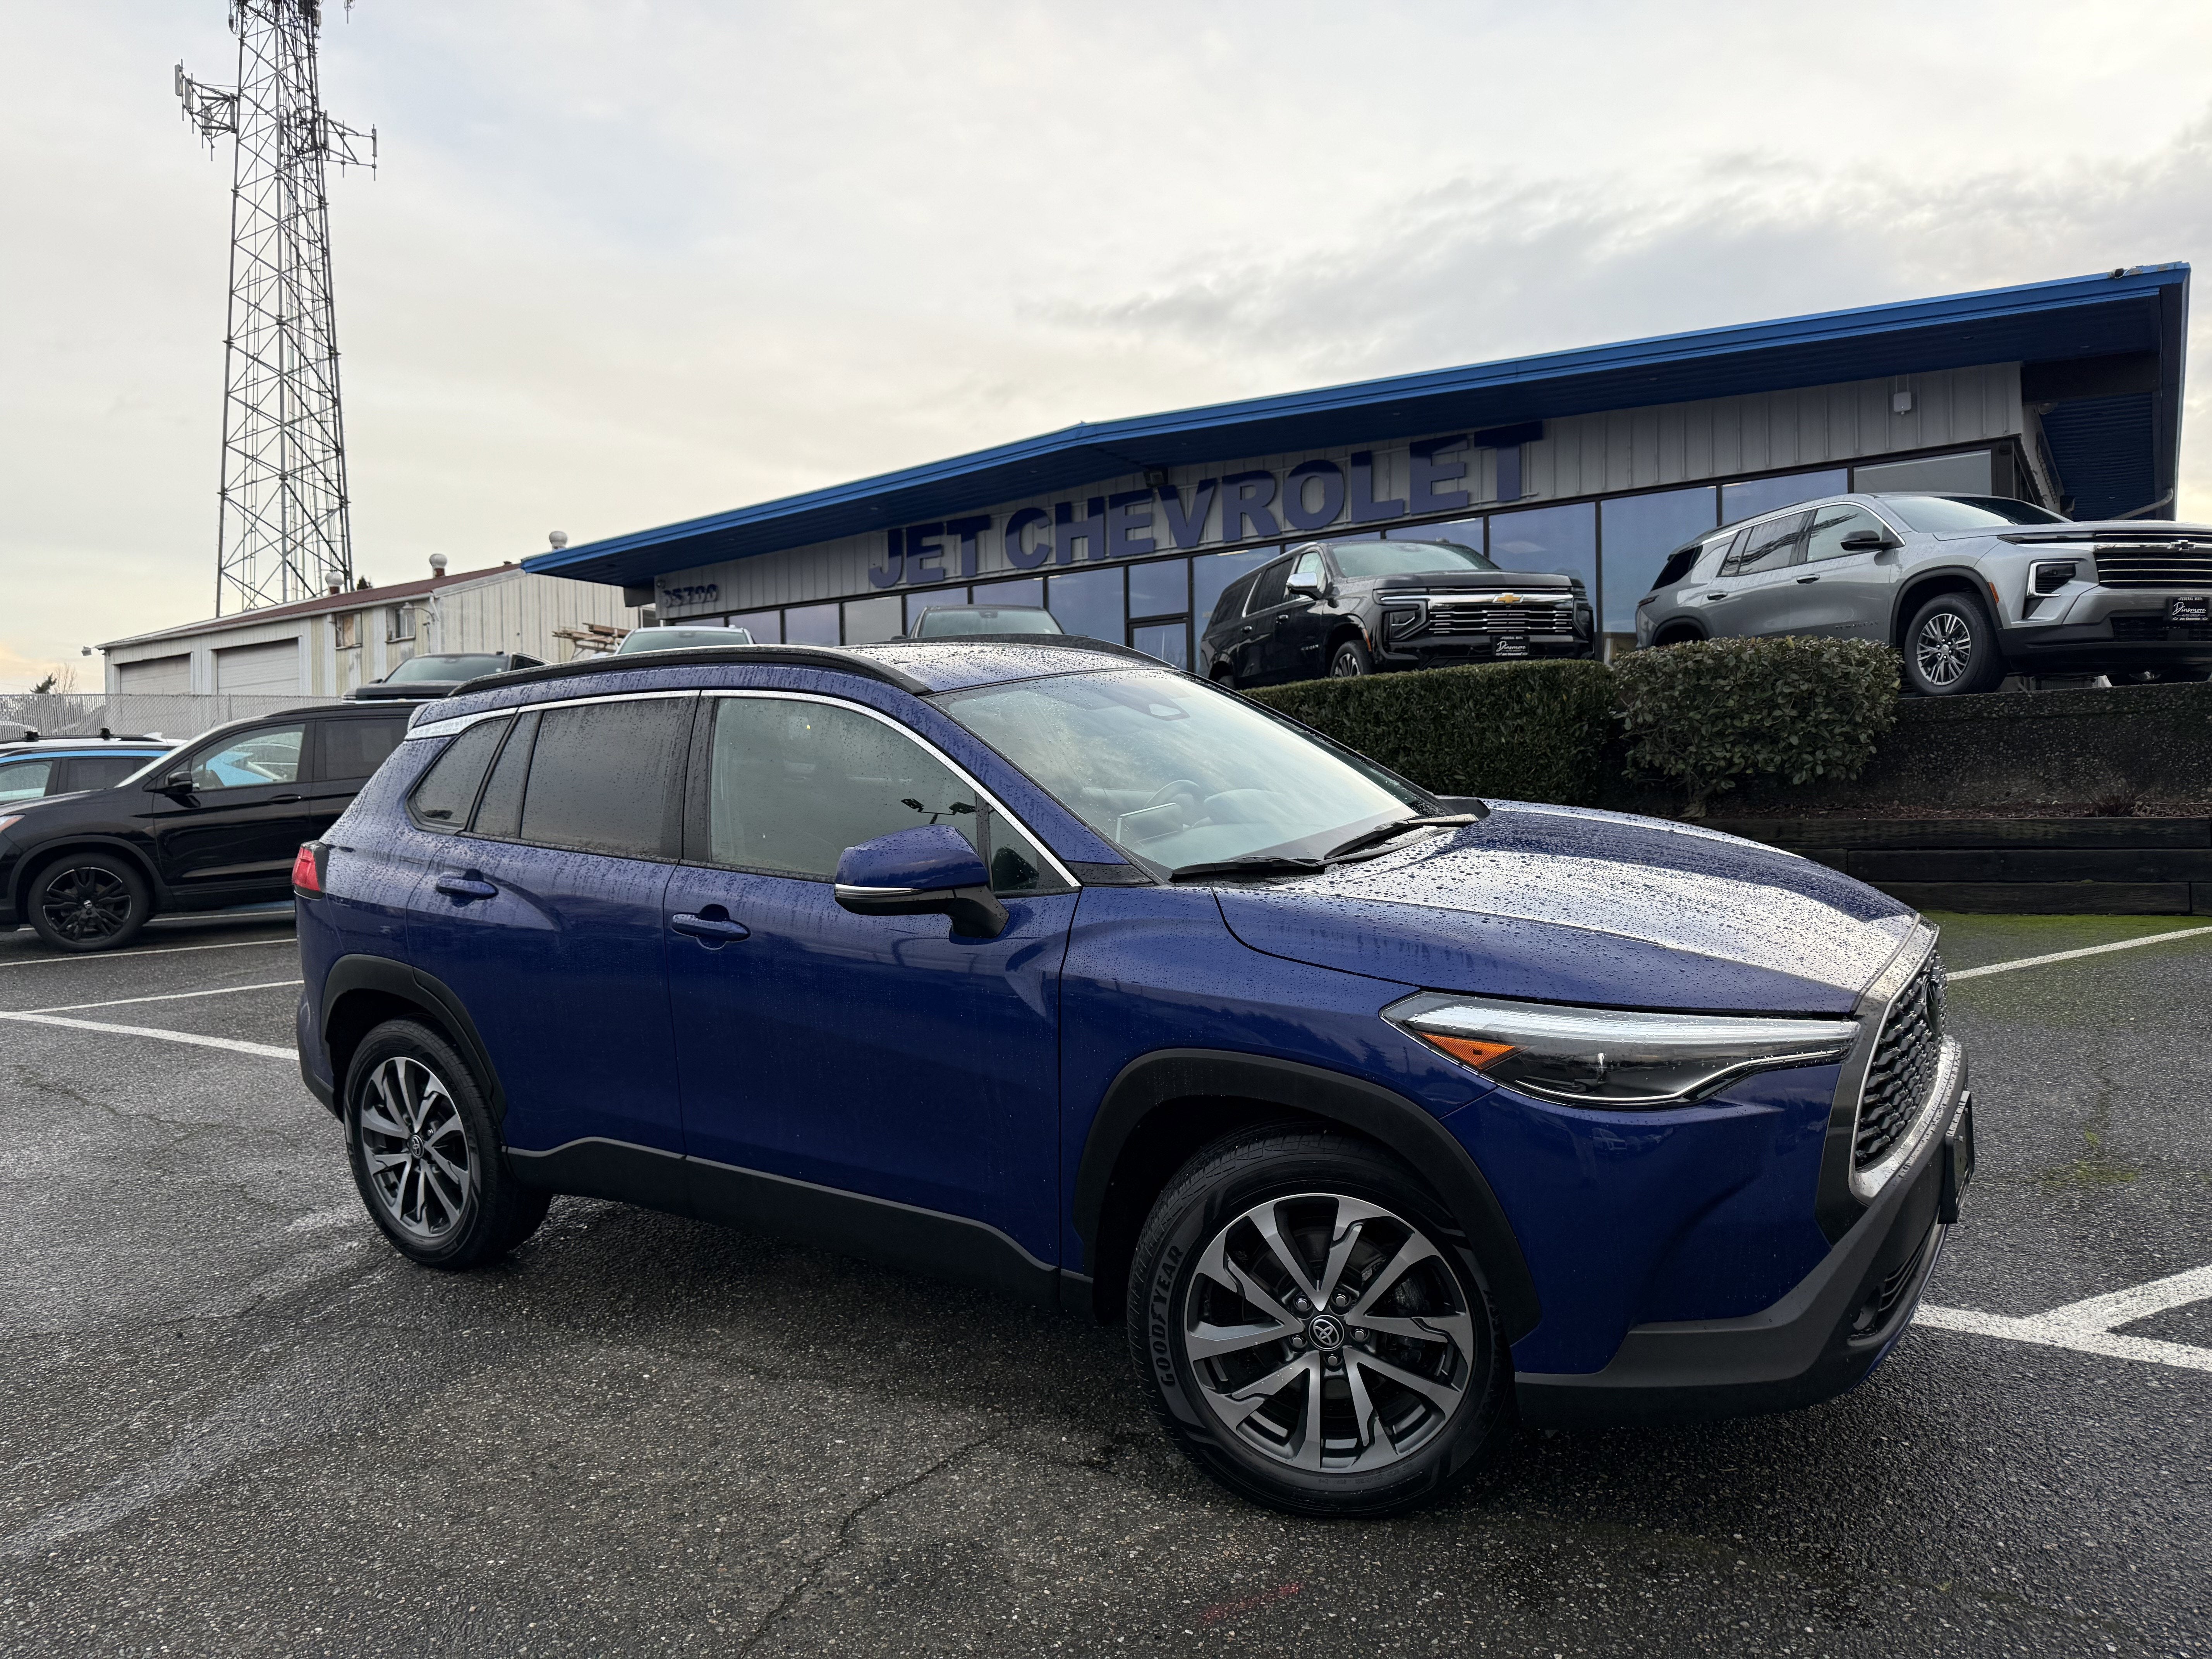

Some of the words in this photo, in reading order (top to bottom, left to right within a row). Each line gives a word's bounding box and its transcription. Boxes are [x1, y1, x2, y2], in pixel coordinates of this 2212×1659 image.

[869, 515, 991, 588] JET
[1005, 420, 1543, 569] CHEVROLET
[2172, 601, 2207, 615] Dinsmore
[1151, 1245, 1183, 1387] GOODYEAR
